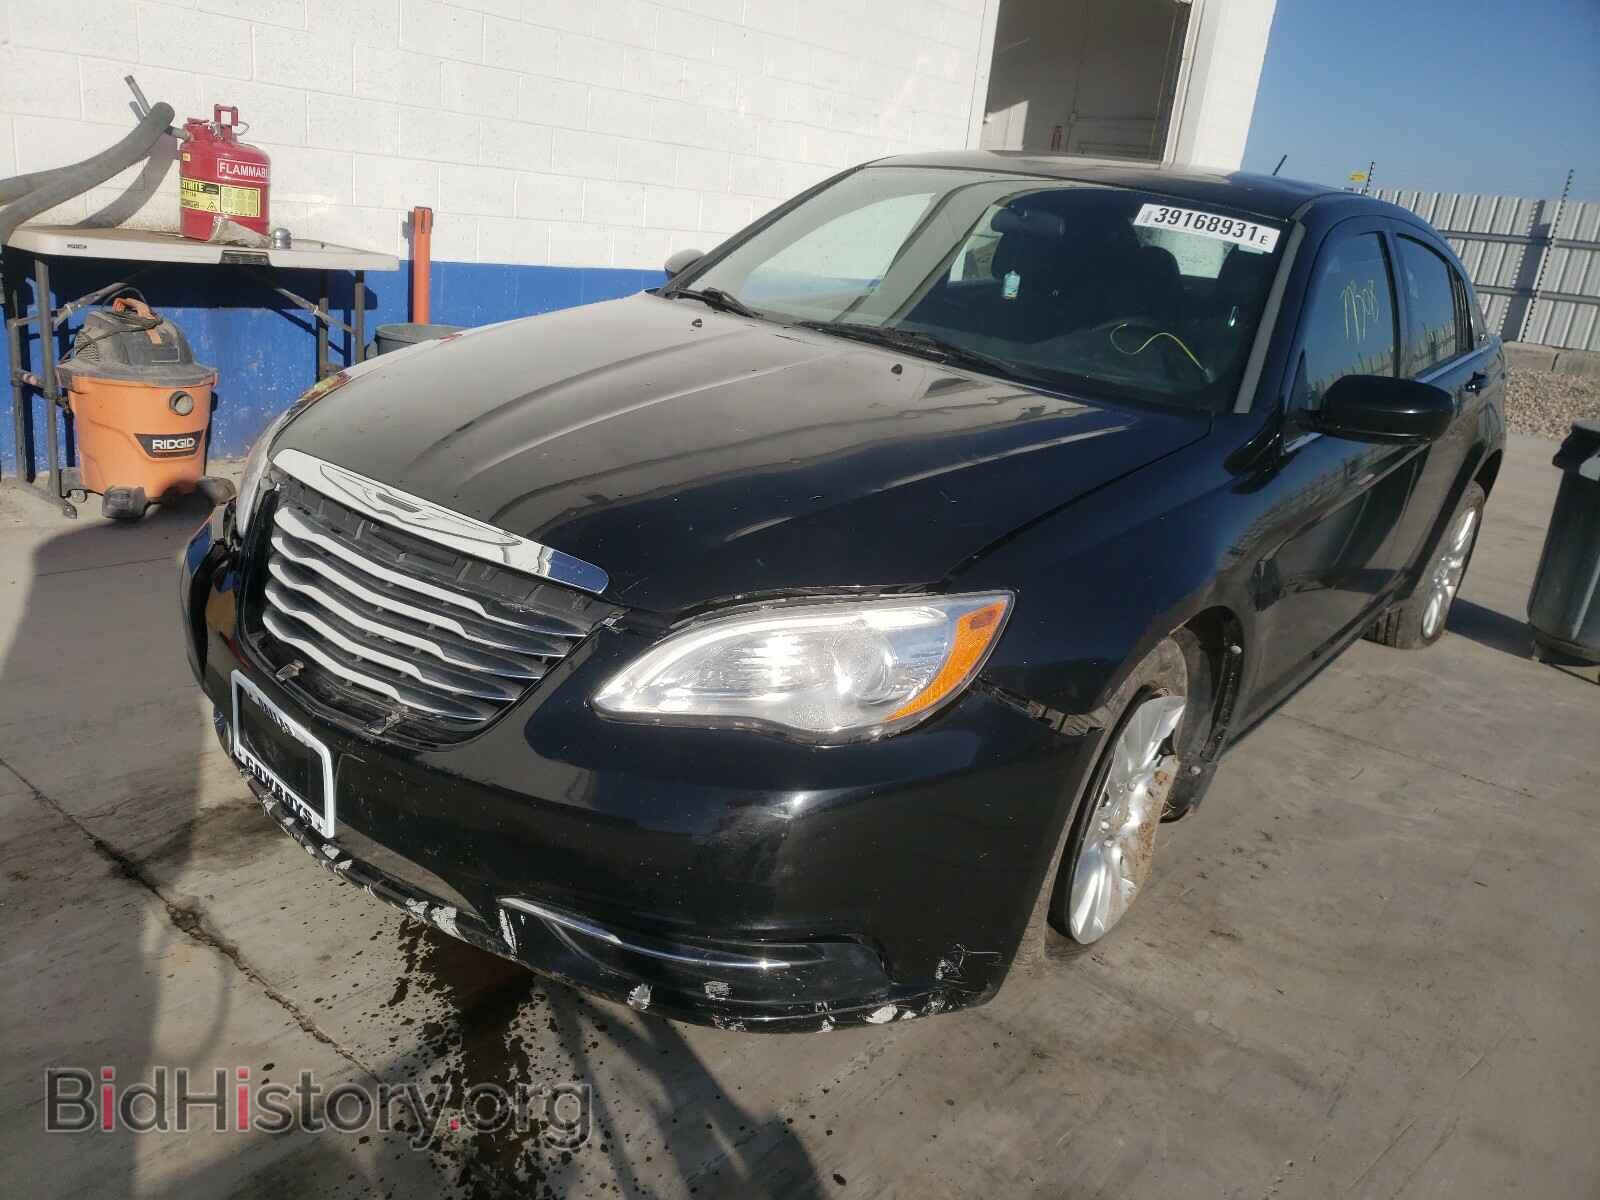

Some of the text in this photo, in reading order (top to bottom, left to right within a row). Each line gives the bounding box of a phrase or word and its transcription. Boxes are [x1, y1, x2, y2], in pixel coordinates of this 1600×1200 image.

[1154, 207, 1258, 241] 39168931
[1260, 235, 1269, 245] E
[152, 437, 196, 450] RIDGID
[245, 757, 313, 826] COWBOYS
